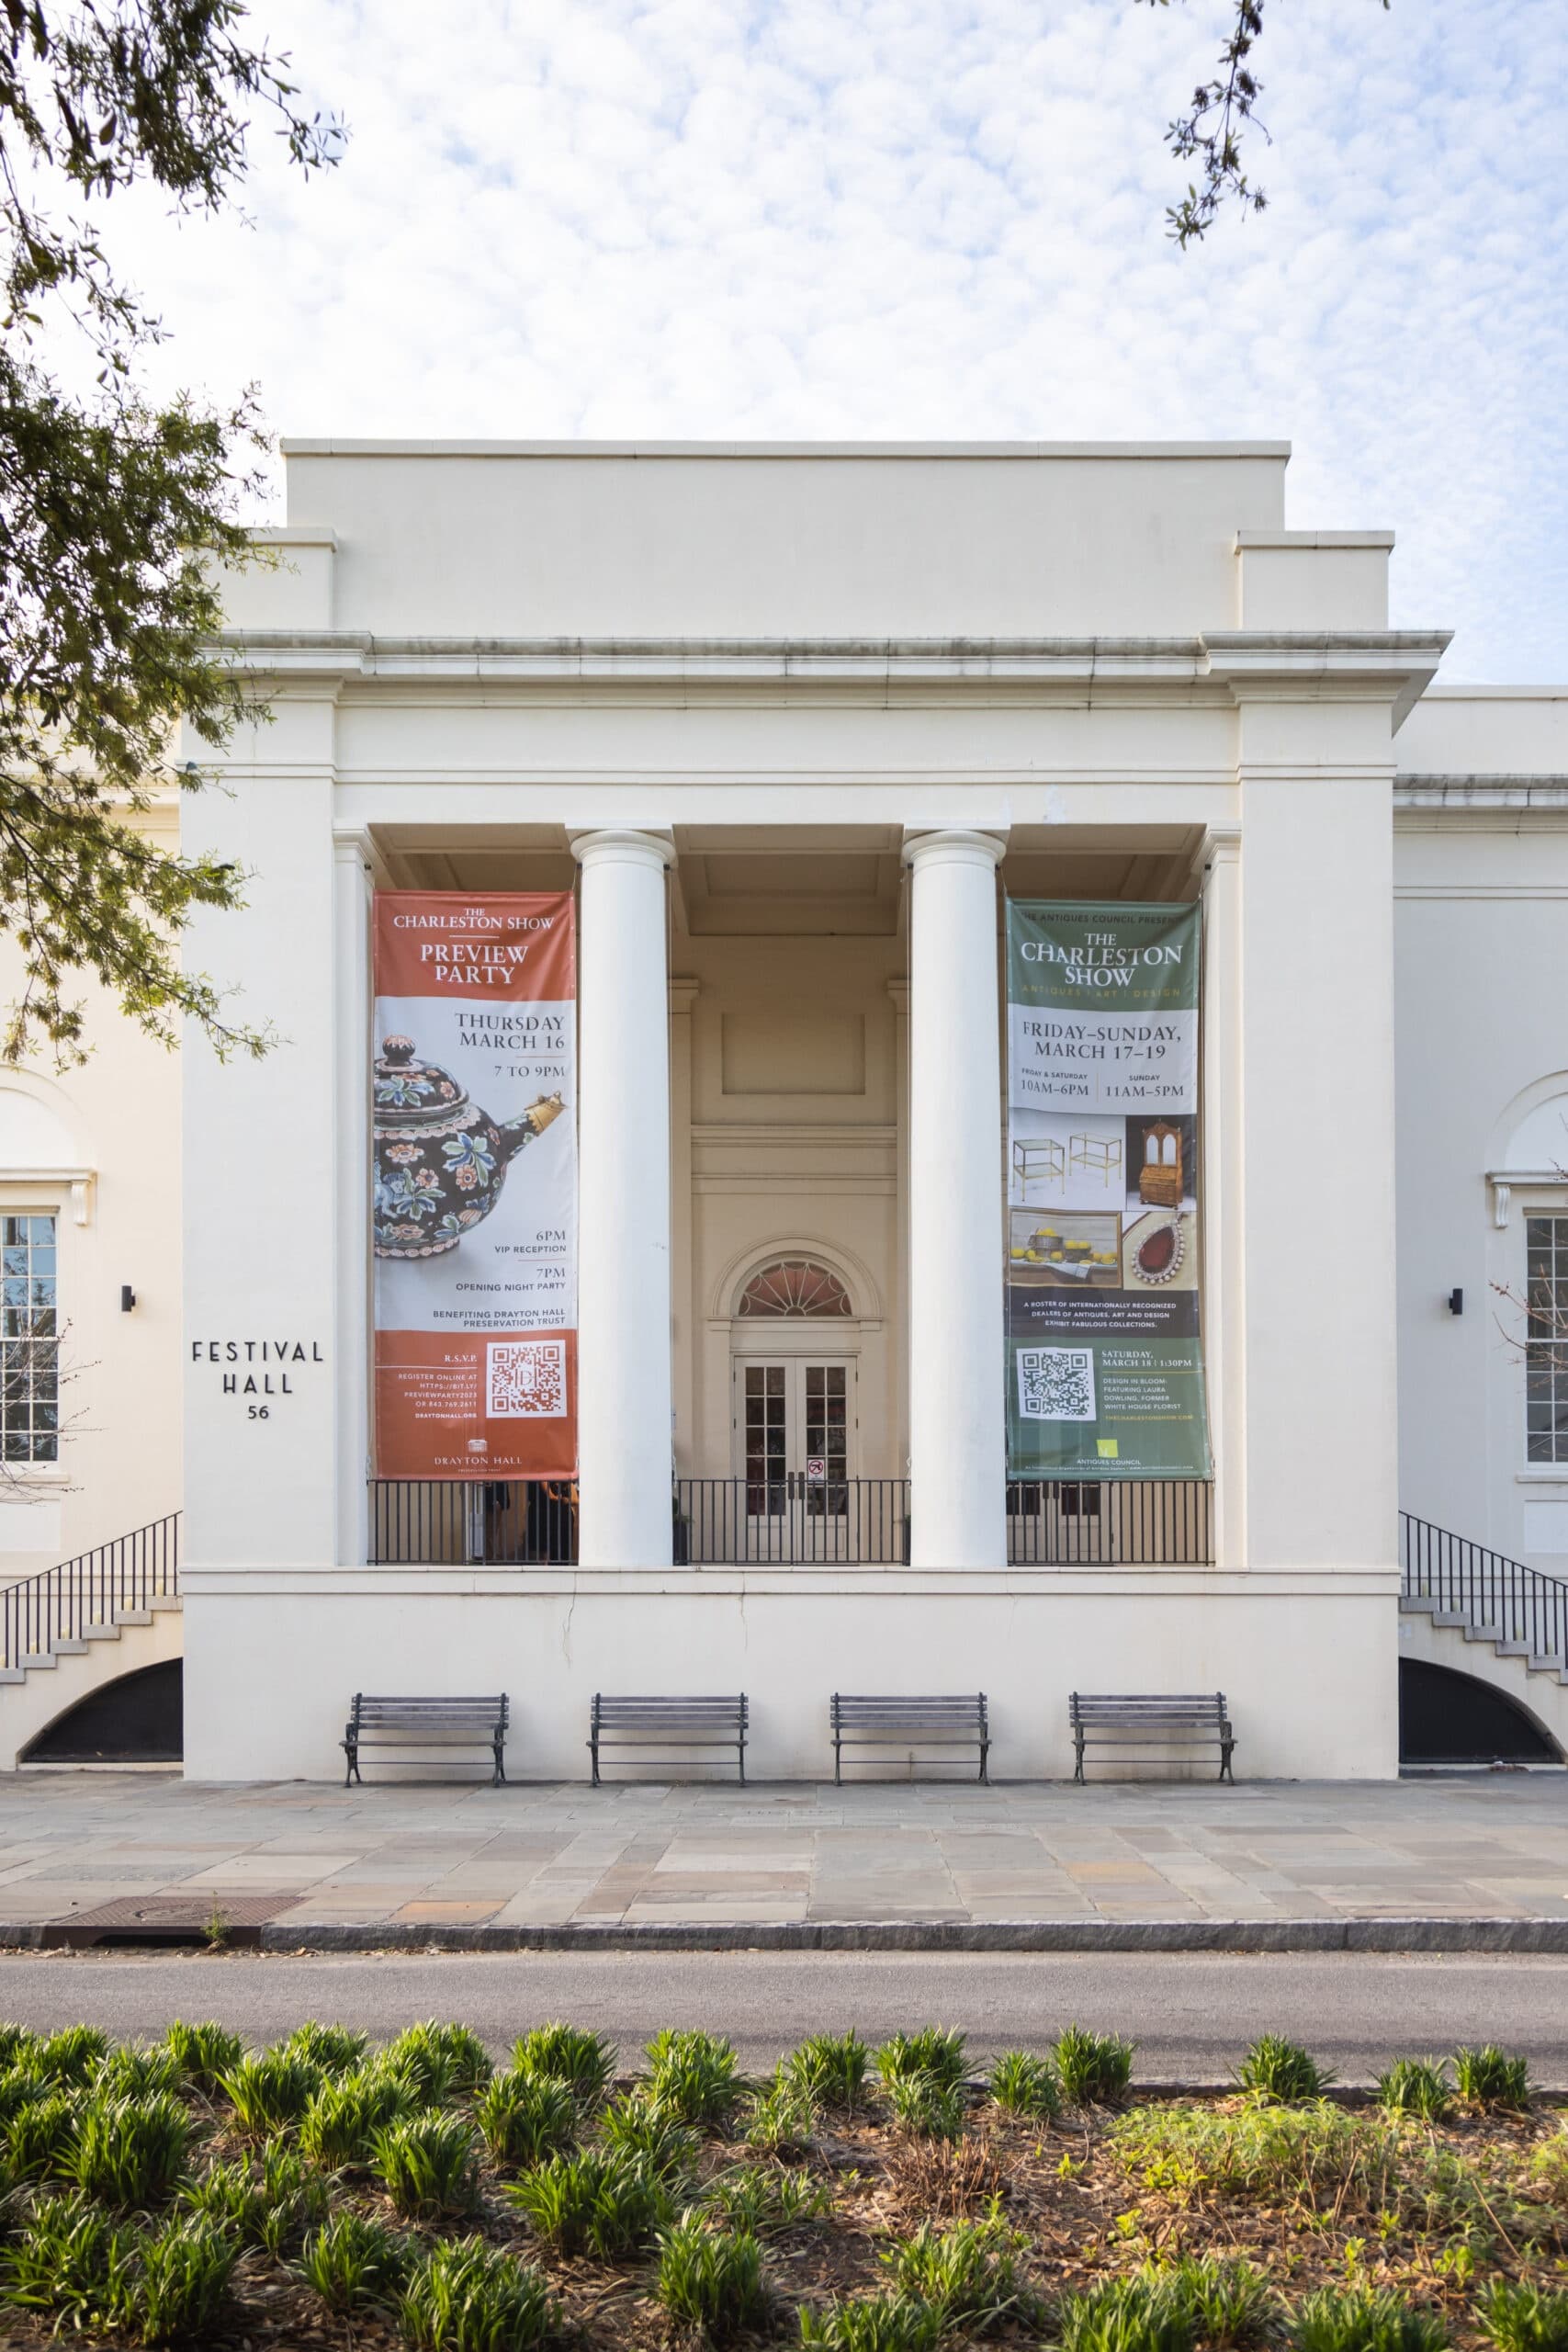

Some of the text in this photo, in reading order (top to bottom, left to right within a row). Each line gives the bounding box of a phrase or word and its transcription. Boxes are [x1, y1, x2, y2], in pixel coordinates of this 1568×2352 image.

[393, 916, 555, 930] CHARLESTON SHOW
[1093, 915, 1133, 924] COUNCIL
[1084, 933, 1117, 946] THE
[420, 944, 529, 964] PREVIEW
[1021, 942, 1183, 966] CHARLESTON
[435, 965, 515, 984] PARTY
[1065, 966, 1136, 987] SHOW
[1021, 984, 1181, 998] ANTIQUES ART DESIGN
[455, 1012, 565, 1031] THURSDAY
[459, 1032, 565, 1050] MARCH 16
[1035, 1041, 1105, 1059] MARCH
[494, 1066, 565, 1077] 7 TO 9PM
[1021, 1067, 1042, 1077] FRIDAY
[1051, 1071, 1088, 1080] SATURDAY
[536, 1230, 566, 1241] 6PM
[495, 1244, 567, 1254] VIP RECEPTION
[536, 1267, 566, 1278] 7PM
[456, 1282, 566, 1292] OPENING NIGHT PARTY
[433, 1308, 565, 1319] BENEFITING DRAYTON HALL
[463, 1317, 566, 1328] PRESERVATION TRUST
[192, 1341, 324, 1362] FESTIVAL
[1102, 1350, 1154, 1359] SATURDAY,
[444, 1354, 477, 1363] R.S.V.P.
[1102, 1359, 1139, 1367] MARCH
[223, 1374, 293, 1394] HALL
[248, 1405, 270, 1419] 56
